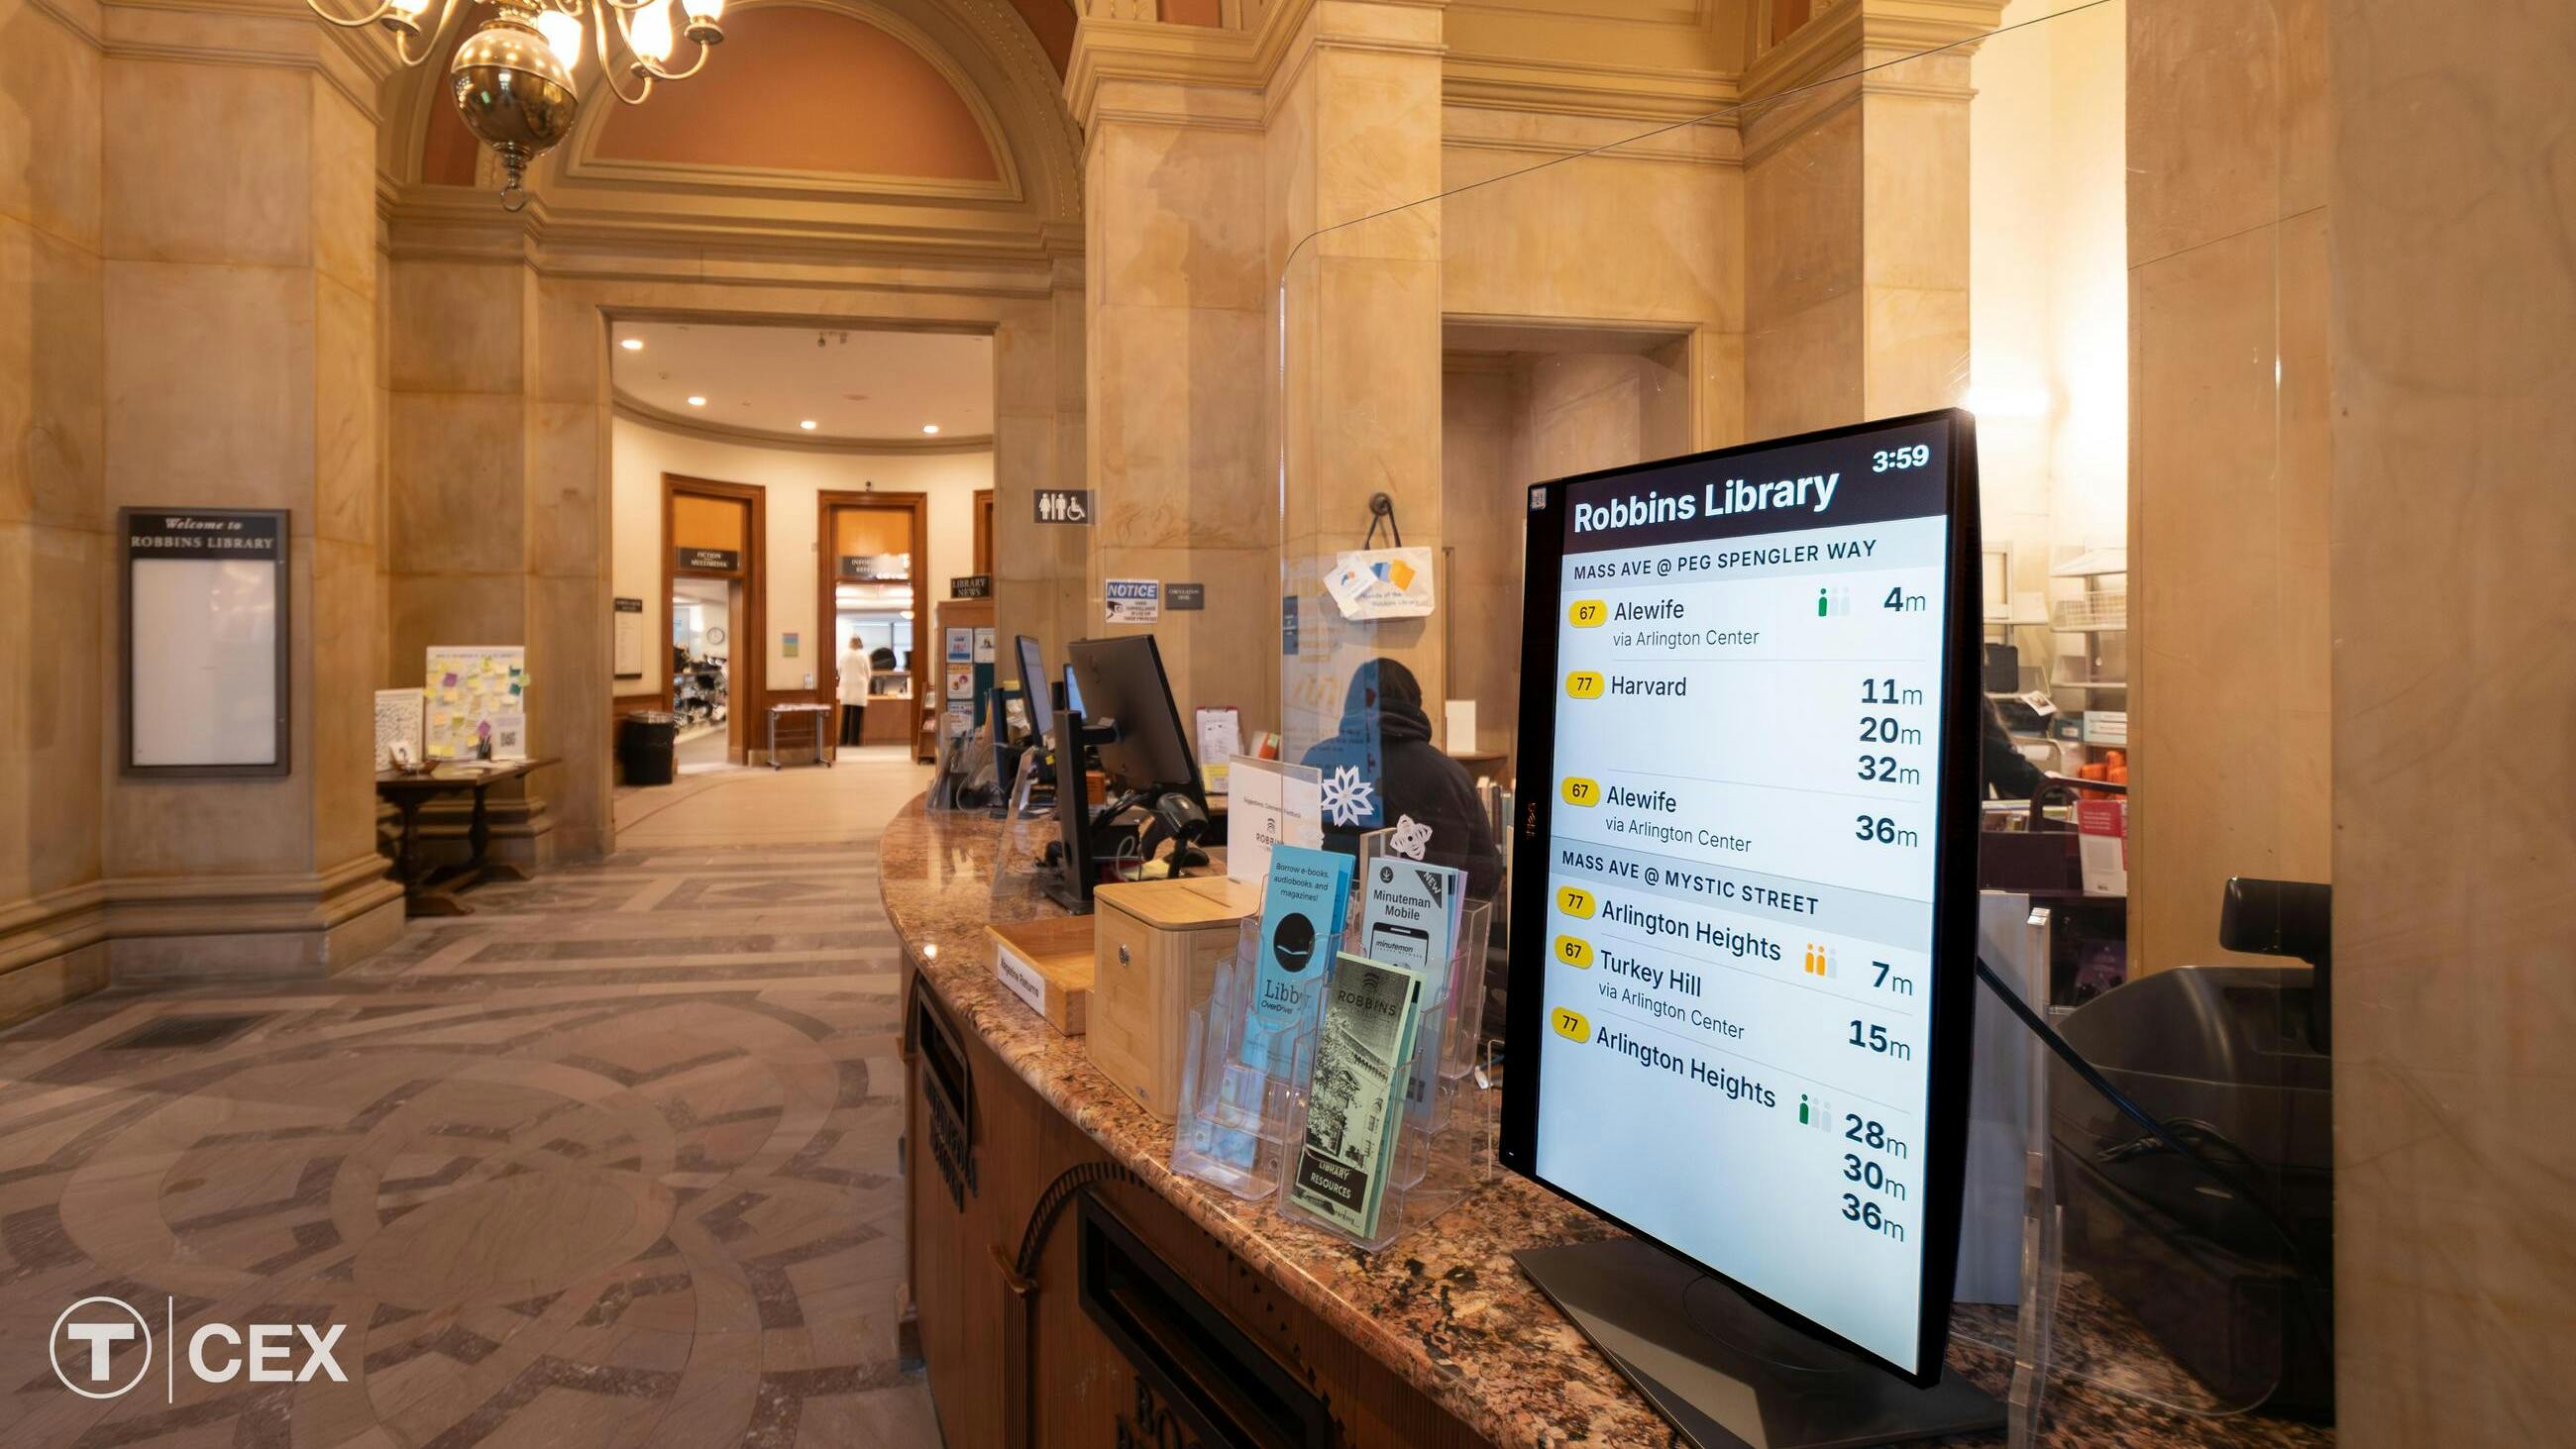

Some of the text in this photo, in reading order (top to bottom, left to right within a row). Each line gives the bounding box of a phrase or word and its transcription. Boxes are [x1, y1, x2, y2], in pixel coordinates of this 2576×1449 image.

[1873, 444, 1930, 473] 3:59
[1573, 472, 1840, 533] Robbins Library
[164, 517, 243, 531] Welcome to
[131, 536, 273, 550] ROBBINS LIBRARY
[1573, 540, 1878, 580] MASS AVE @ PEG SPENGLER WAY
[1108, 584, 1156, 597] NOTICE
[1579, 586, 1926, 622] 67 Alewife 4m
[1613, 629, 1760, 650] via Arlington Center
[1576, 676, 1923, 705] 77 Harvard 11m
[1859, 717, 1921, 745] 20m
[1857, 755, 1920, 785] 32m
[1571, 783, 1918, 848] 67 Alewife 36m
[1605, 818, 1752, 852] via Arlington Center
[1275, 863, 1300, 874] Borrow
[1280, 889, 1319, 901] magazines!
[1314, 882, 1329, 891] and
[1423, 873, 1442, 894] NEW
[1562, 851, 1819, 915] MASS AVE @ MYSTIC STREET
[1373, 889, 1431, 908] Minuteman
[1385, 904, 1421, 920] Mobile
[1375, 940, 1414, 953] minuteman
[1567, 894, 1913, 996] 77 Arlington Heights 7m
[1338, 990, 1397, 1016] ROBBINS
[1565, 942, 1910, 1062] 67 Turkey Hill 15m
[1598, 983, 1745, 1040] via Arlington Center
[1561, 1015, 1908, 1160] 77 Arlington Heights 28m
[1319, 1160, 1350, 1181] LIBRARY
[1843, 1153, 1906, 1201] 30m
[1310, 1172, 1352, 1199] RESOURCES
[1841, 1192, 1905, 1243] 36m
